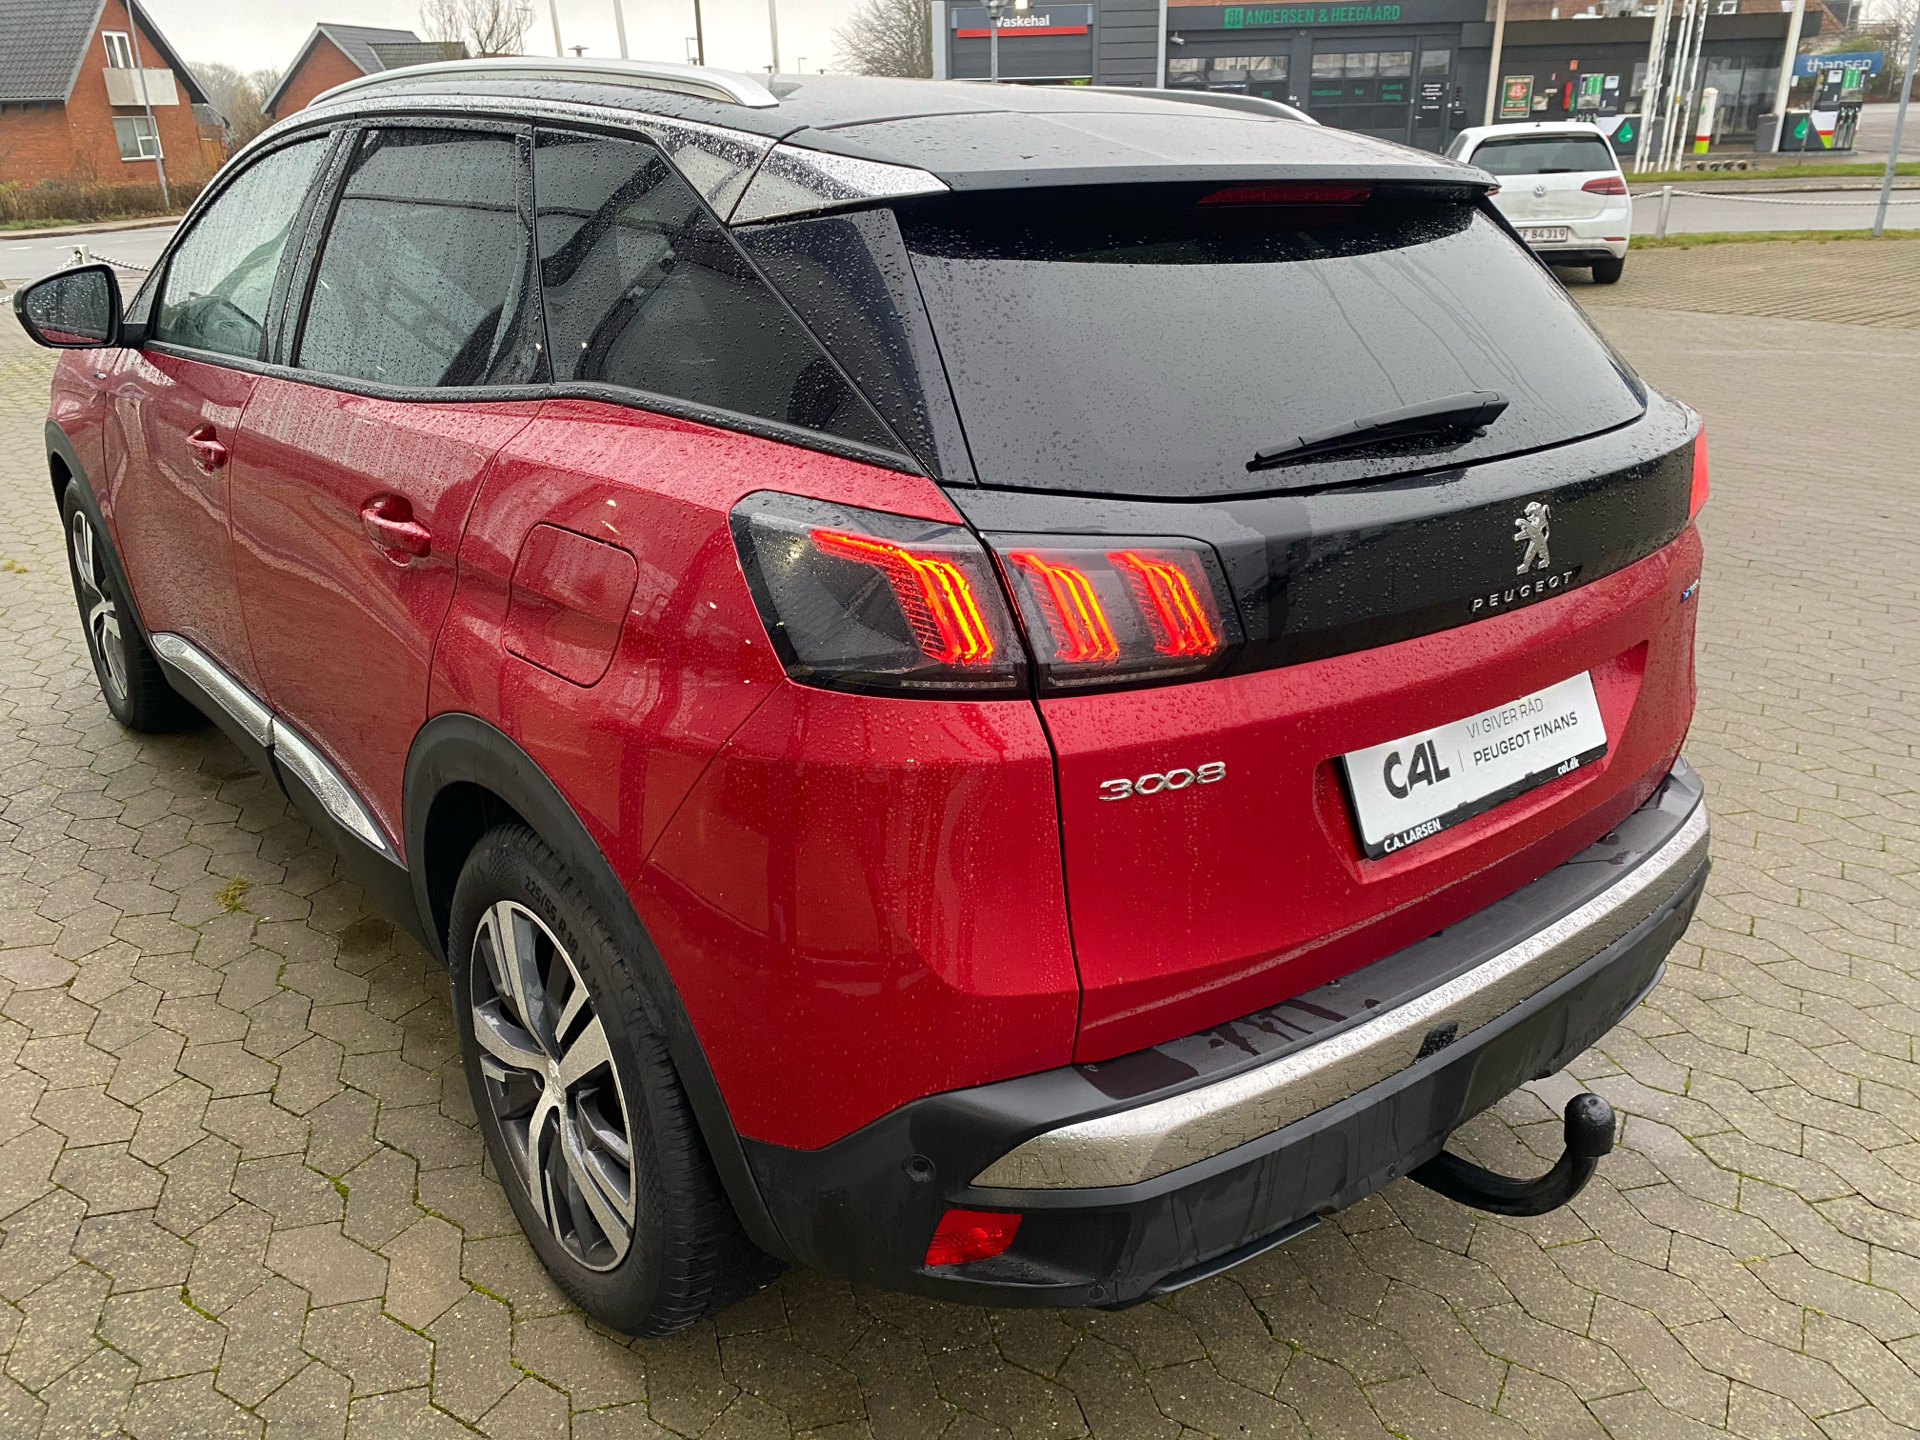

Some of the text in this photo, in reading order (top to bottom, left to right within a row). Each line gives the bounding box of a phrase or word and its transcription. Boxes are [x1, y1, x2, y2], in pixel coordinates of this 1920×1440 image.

[1245, 8, 1314, 25] ANDERSEN
[1318, 8, 1328, 23] &
[1331, 5, 1401, 22] HEEGAARD
[1531, 229, 1544, 239] 84
[1546, 228, 1566, 239] 319
[1472, 571, 1573, 612] PEUGEOT
[1466, 697, 1544, 739] VI GIVER RÅD
[1473, 711, 1578, 766] PEUGEOT FINANS
[1099, 761, 1226, 801] 3008
[1383, 739, 1451, 800] CAL
[1557, 757, 1580, 775] cal.dk
[1383, 818, 1441, 853] C.A. LARSEN
[525, 875, 558, 922] 225/55
